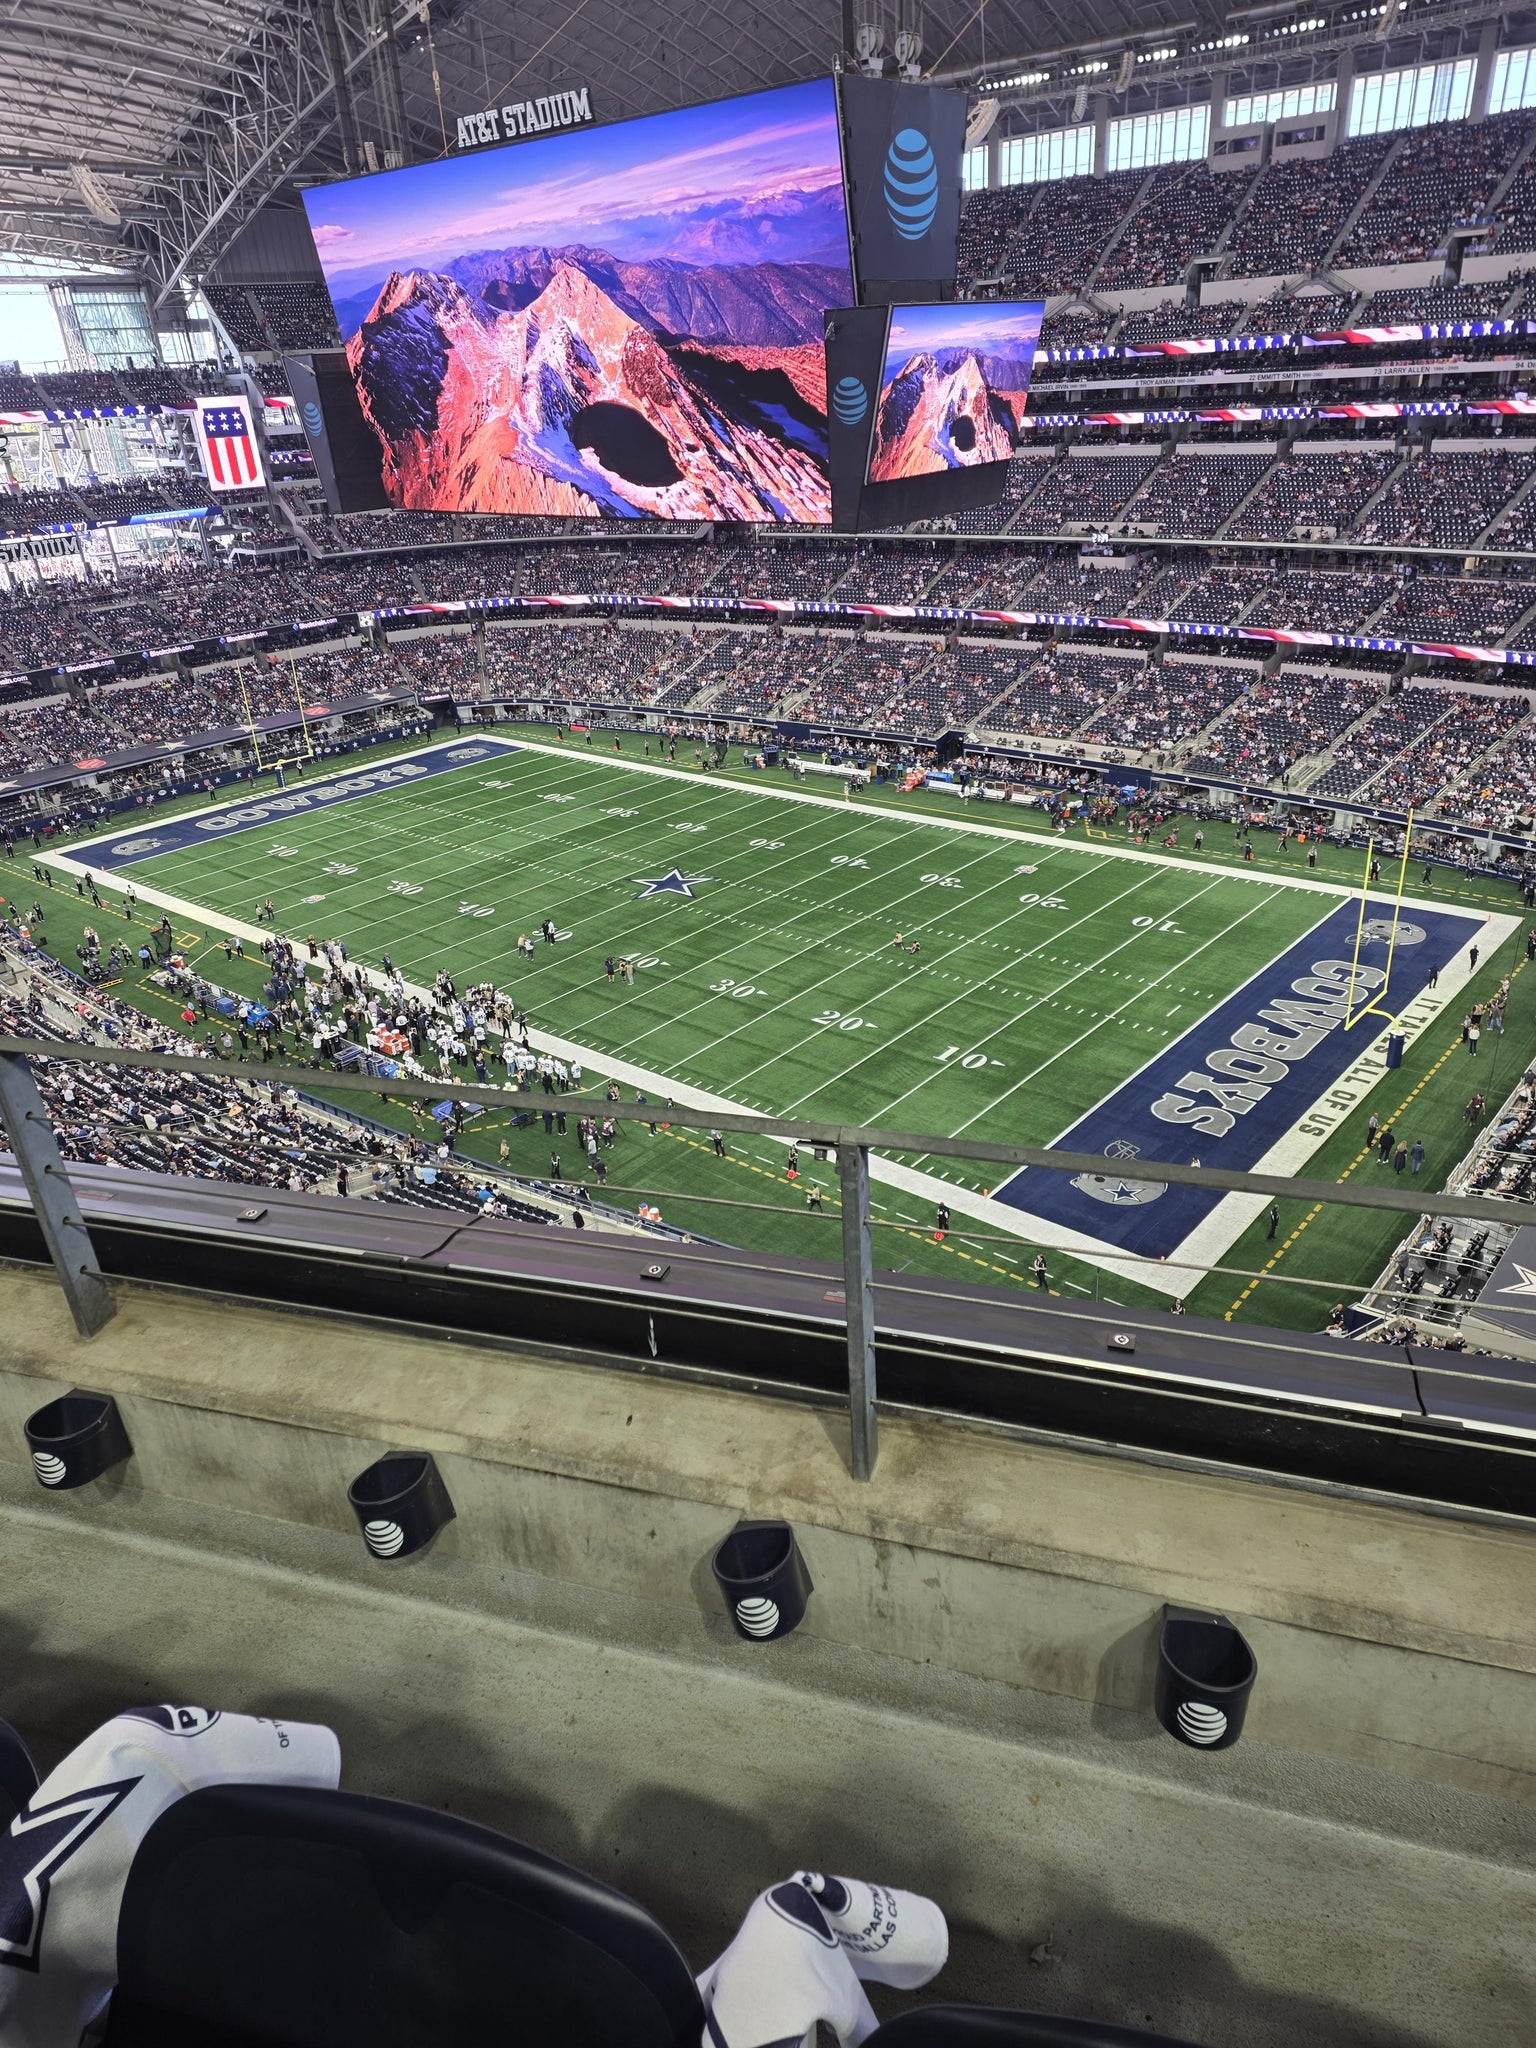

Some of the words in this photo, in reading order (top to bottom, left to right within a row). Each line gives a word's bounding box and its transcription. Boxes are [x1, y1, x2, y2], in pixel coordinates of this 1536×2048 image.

[457, 109, 500, 148] AT&T
[501, 87, 593, 138] STADIUM
[1384, 367, 1407, 375] LARRY
[1408, 366, 1431, 374] ALLEN
[1154, 378, 1176, 386] AIKMAN
[0, 536, 80, 564] STADIUM
[226, 630, 269, 643] Blockchain.com
[150, 643, 195, 658] Blockchain.com
[65, 658, 116, 673] Blockchain.com
[195, 763, 428, 831] COWBOYS
[606, 807, 640, 818] 30
[265, 845, 299, 857] 10
[749, 838, 786, 851] 50
[322, 862, 359, 876] 20
[830, 855, 868, 868] 40
[387, 881, 424, 895] 30
[920, 873, 961, 888] 30
[1019, 893, 1066, 908] 20
[457, 903, 496, 918] 40
[1132, 916, 1180, 932] 10
[709, 978, 756, 998] 30
[1415, 997, 1443, 1012] IT
[811, 1010, 864, 1031] 20
[1150, 959, 1387, 1138] COWBOYS
[933, 1045, 988, 1069] 10
[1343, 1057, 1385, 1084] ALL
[1324, 1089, 1358, 1112] OF
[1298, 1113, 1337, 1137] US
